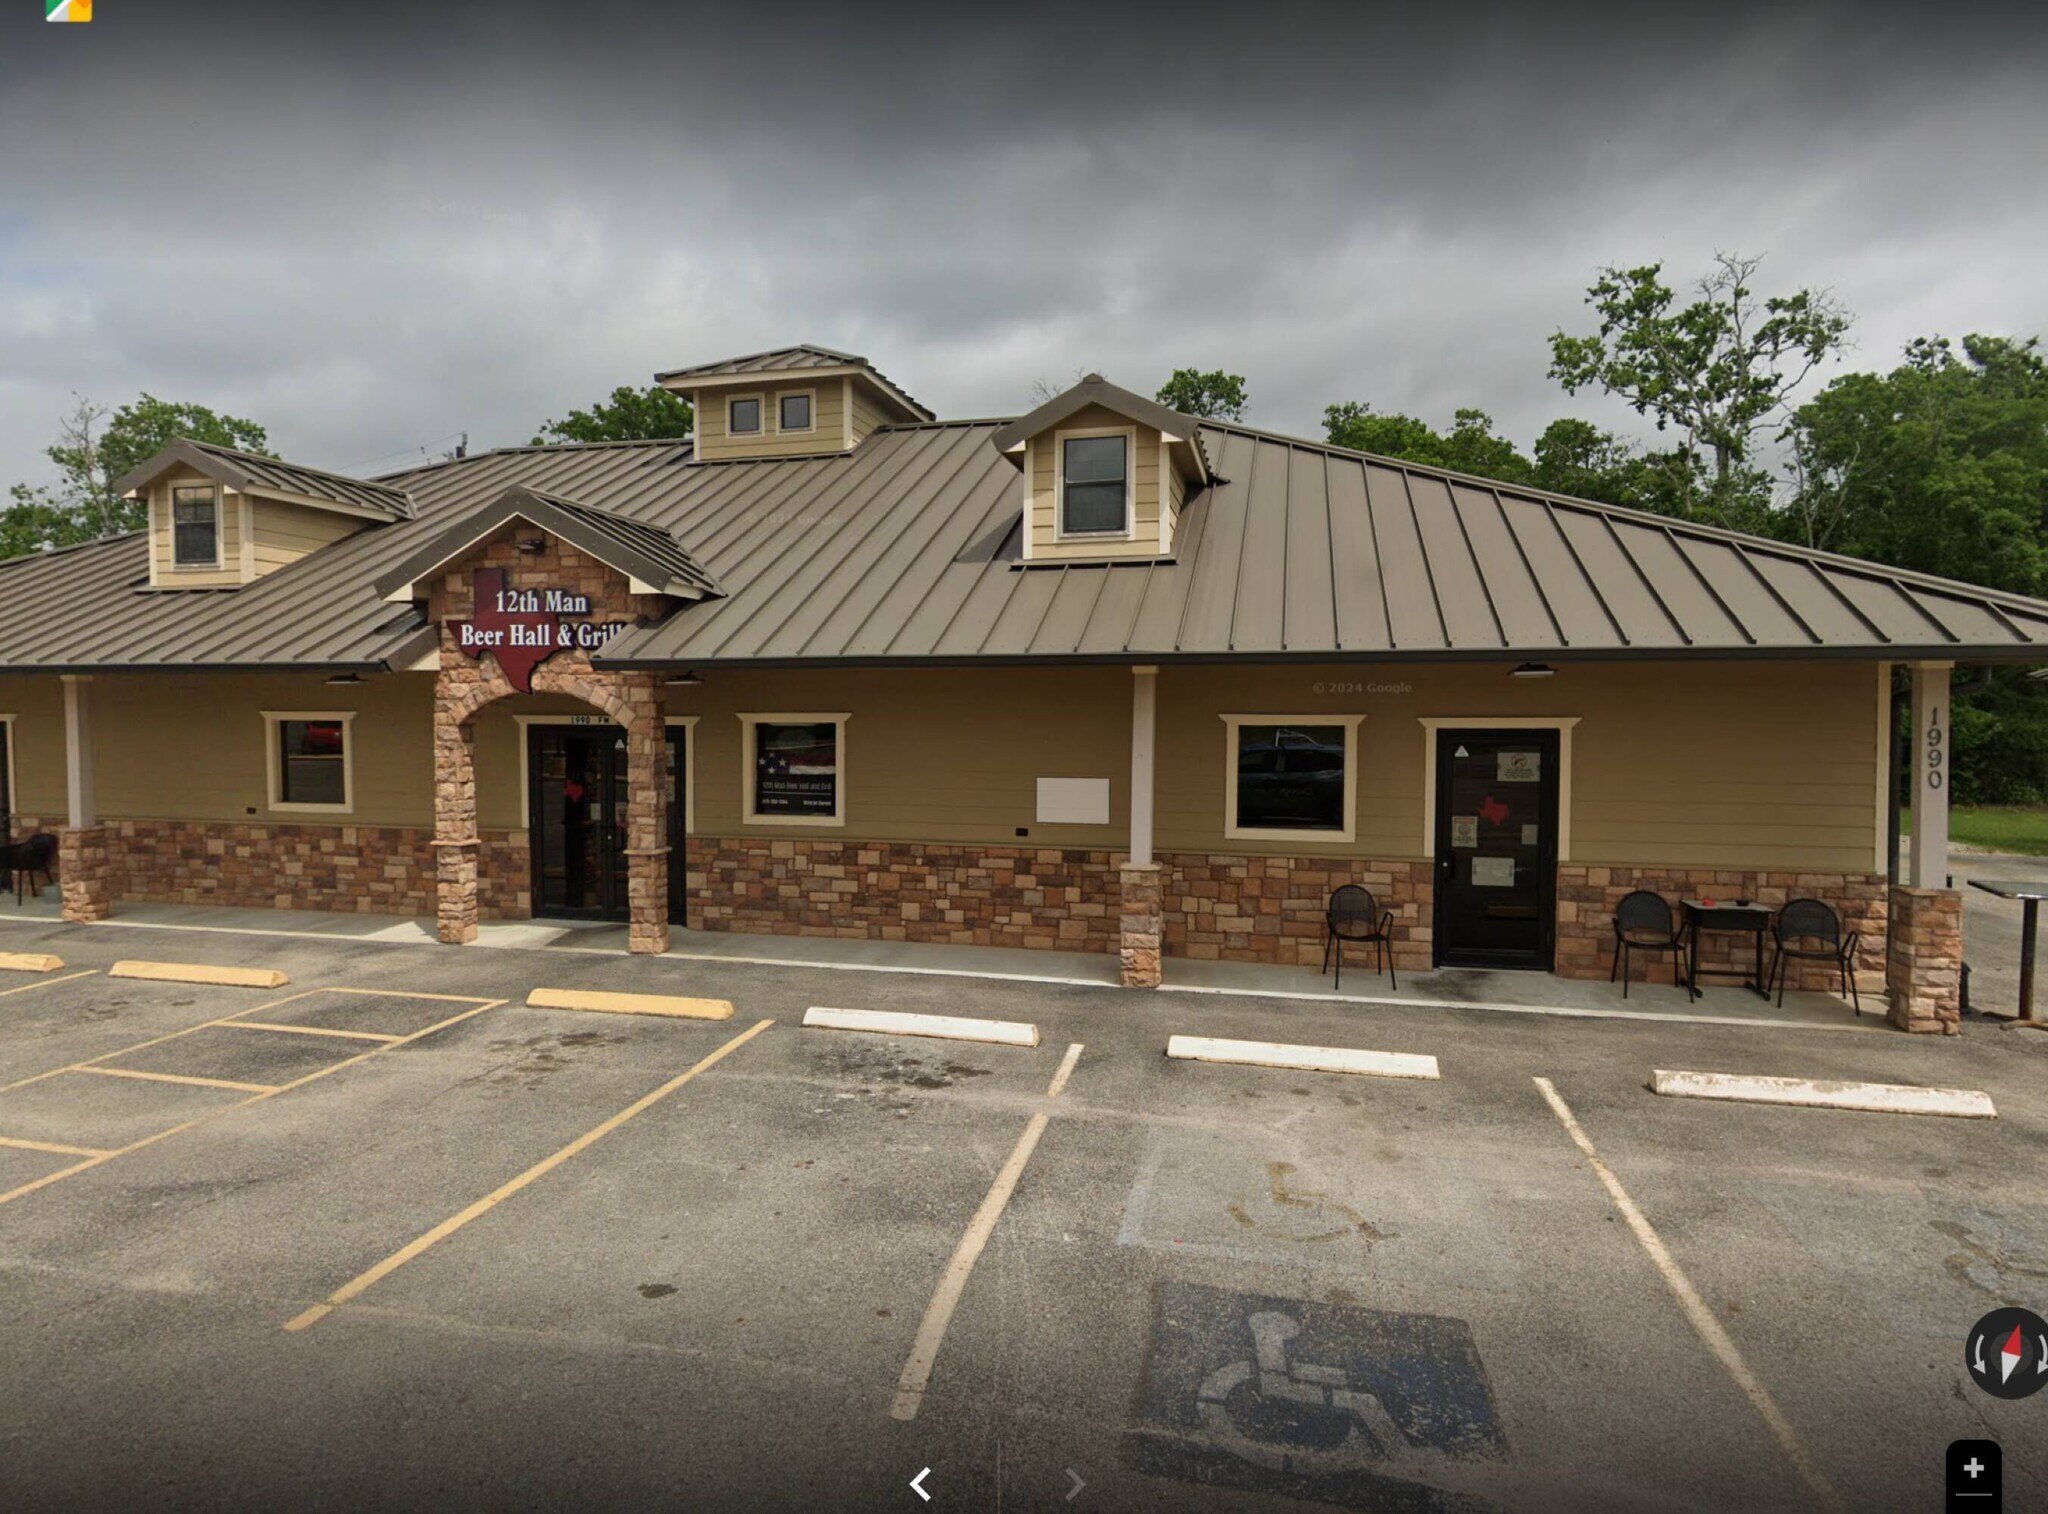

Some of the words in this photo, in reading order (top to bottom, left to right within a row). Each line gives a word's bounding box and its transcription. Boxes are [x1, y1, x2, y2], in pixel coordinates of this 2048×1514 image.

[495, 590, 539, 612] 12th
[545, 590, 587, 612] Man
[461, 624, 504, 646] Beer
[509, 624, 550, 646] Hall
[557, 624, 573, 646] &
[570, 716, 591, 724] 1990
[598, 716, 610, 724] FM
[1927, 706, 1942, 790] 1990
